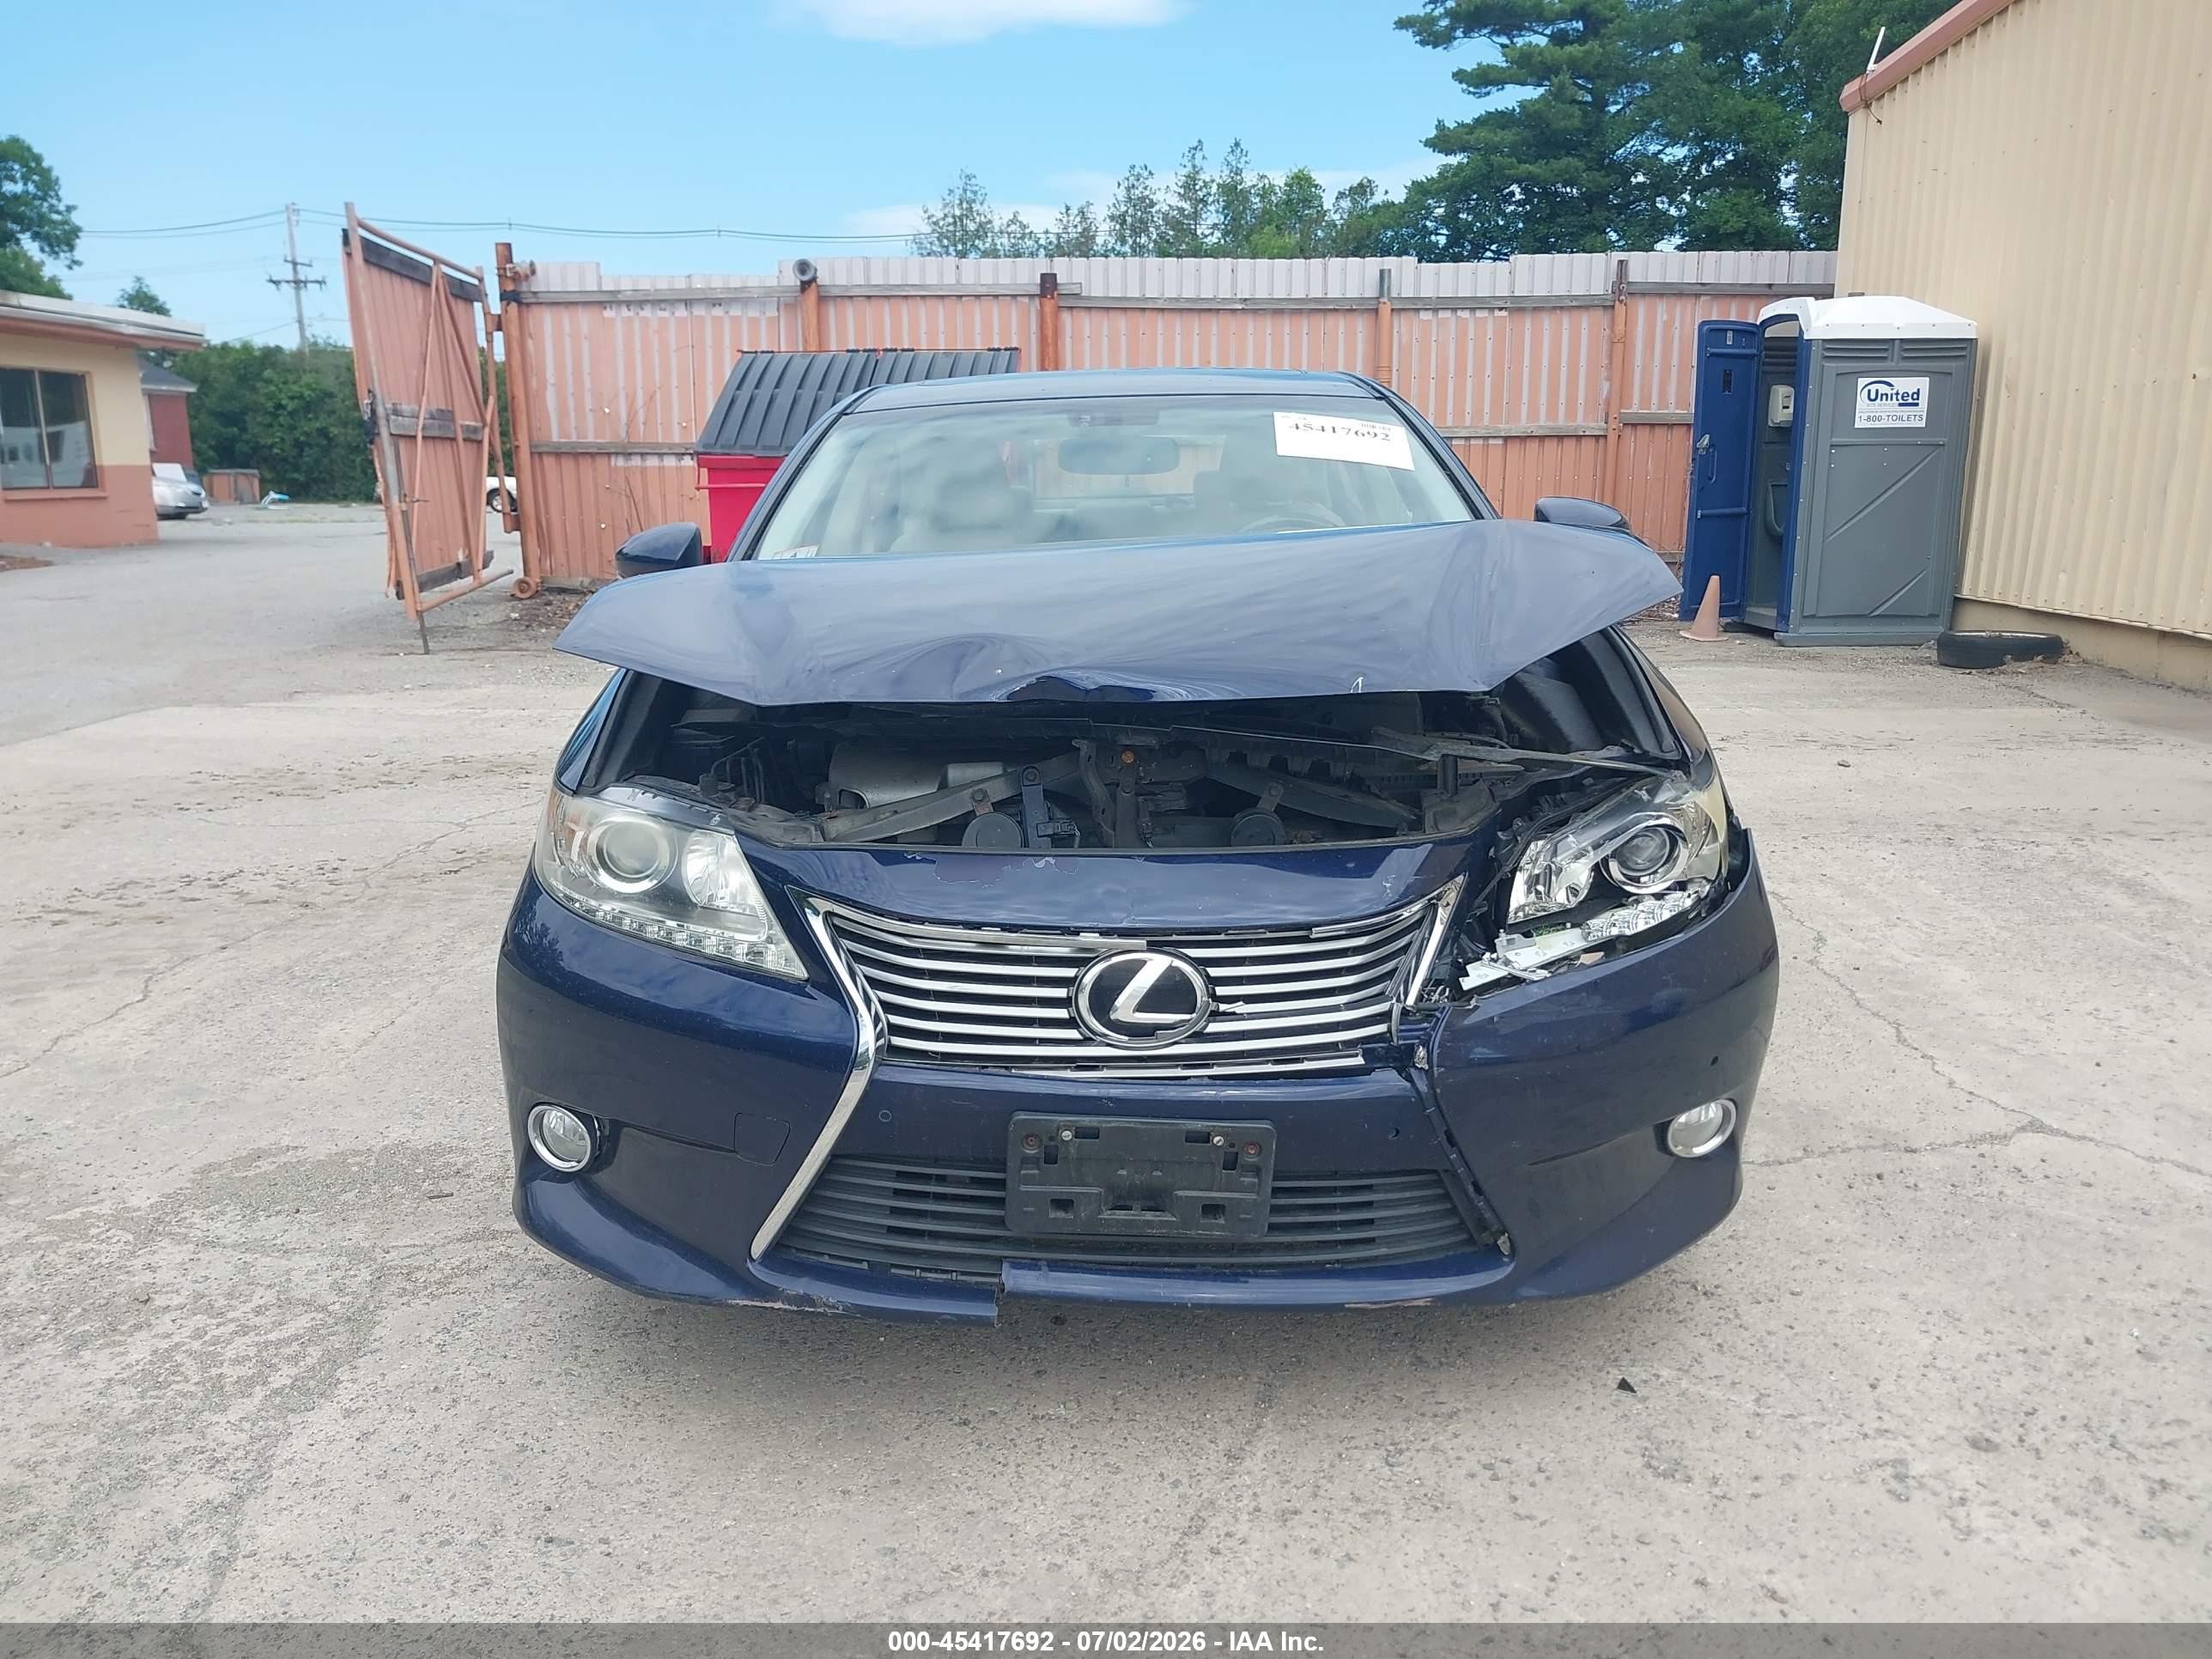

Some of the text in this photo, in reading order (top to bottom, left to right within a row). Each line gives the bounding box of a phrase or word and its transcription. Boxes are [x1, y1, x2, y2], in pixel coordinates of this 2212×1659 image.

[1867, 388, 1920, 402] United
[1858, 414, 1923, 422] 1-800-TOILETS
[1289, 422, 1390, 441] 45417692
